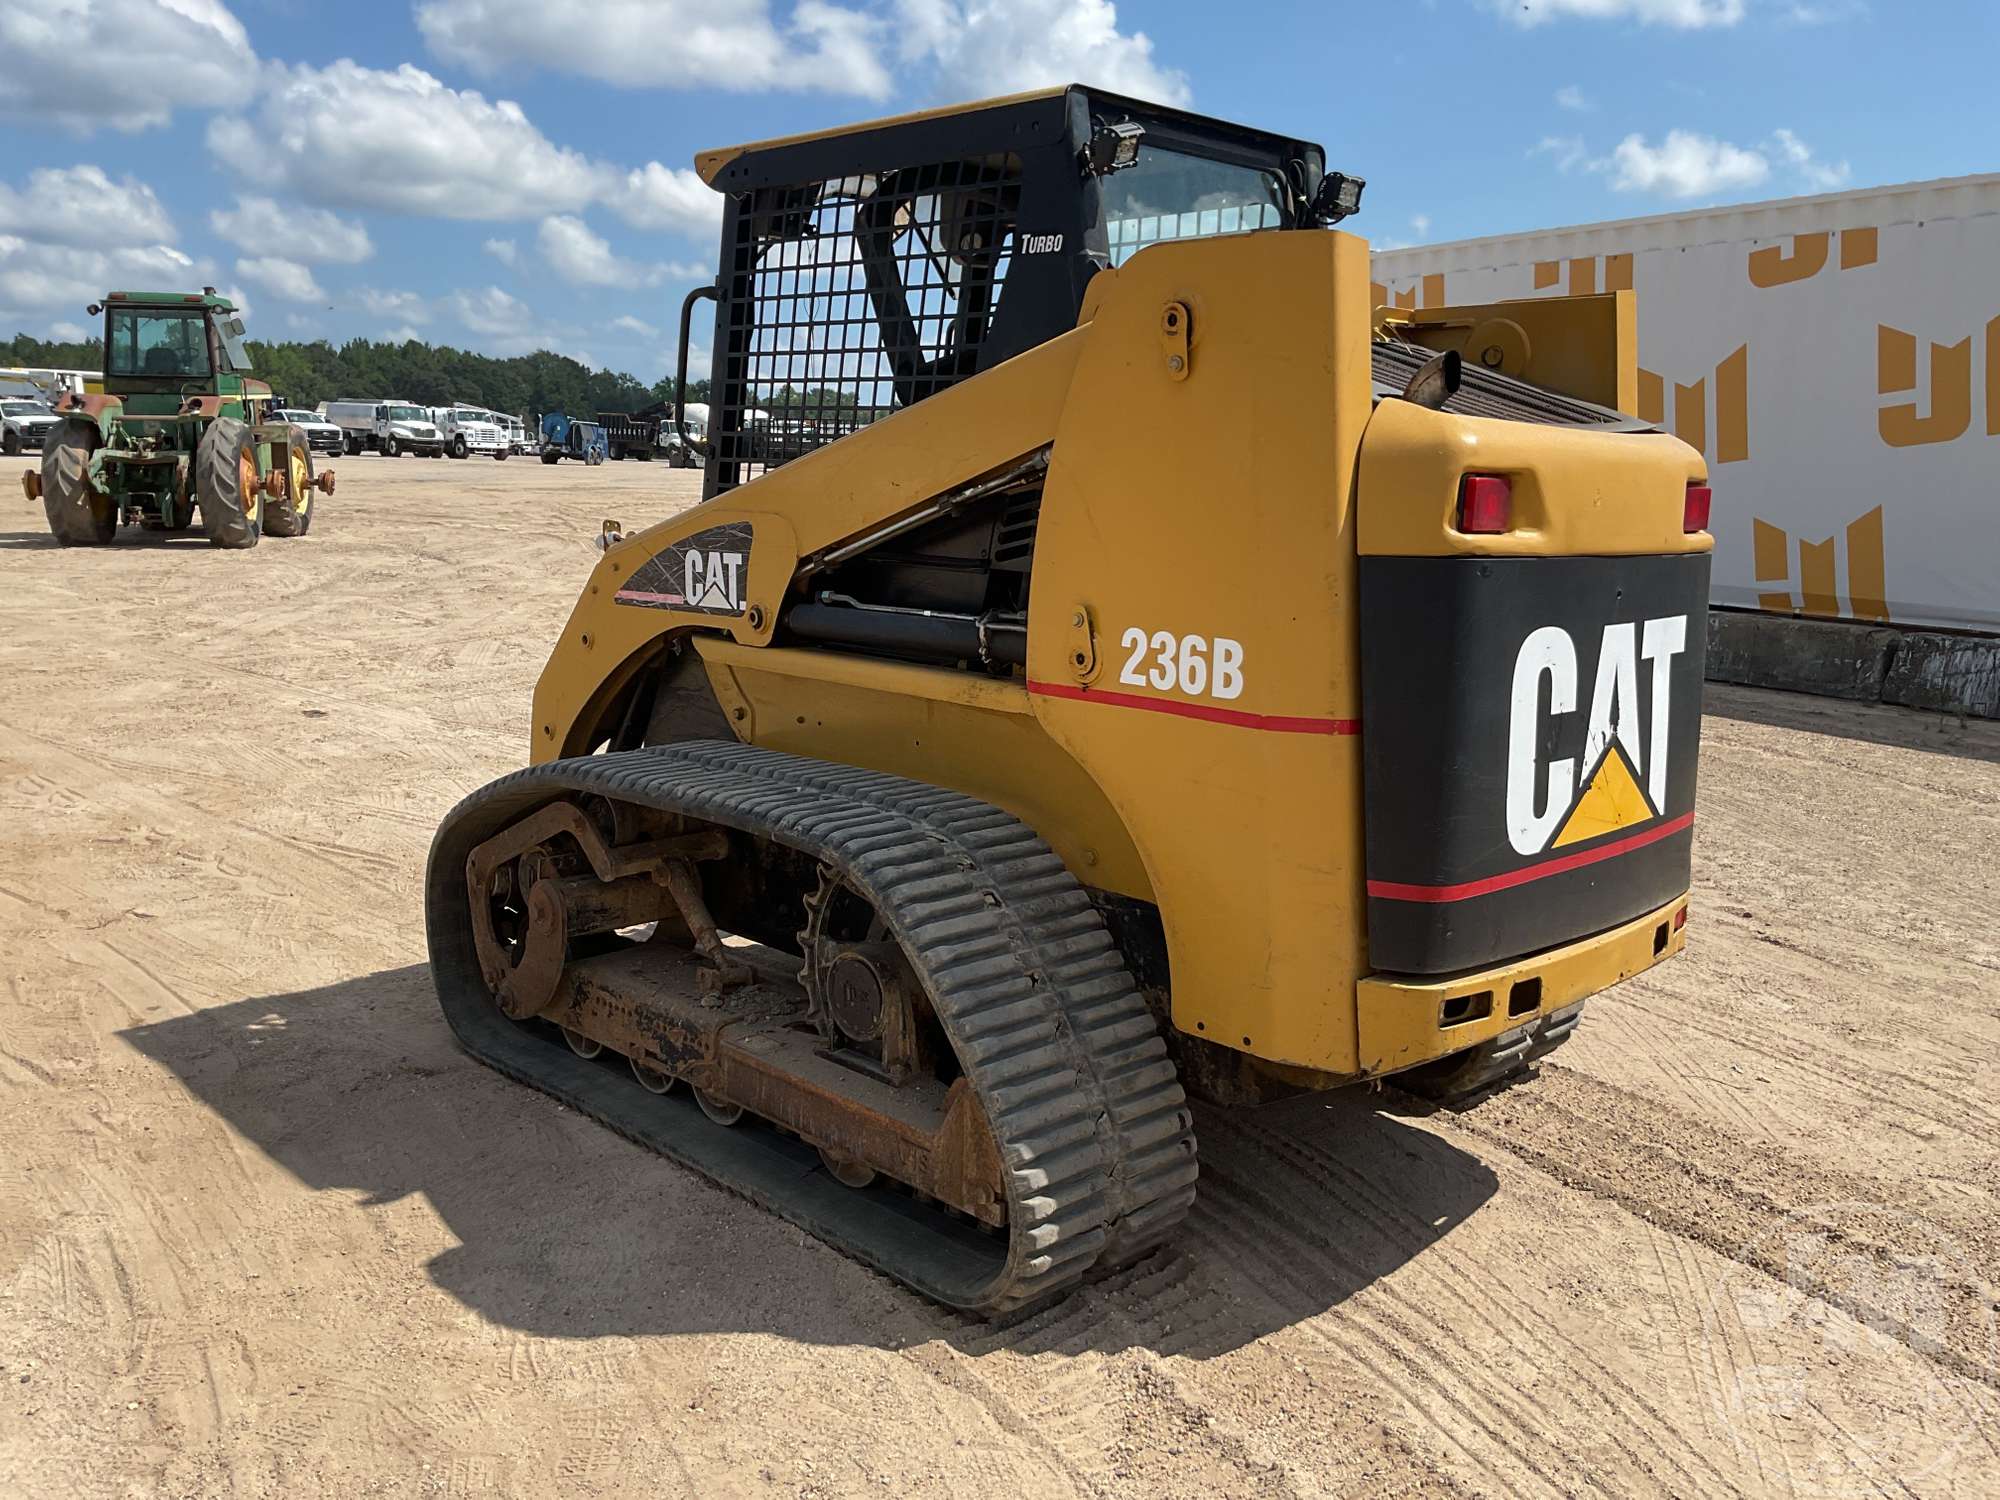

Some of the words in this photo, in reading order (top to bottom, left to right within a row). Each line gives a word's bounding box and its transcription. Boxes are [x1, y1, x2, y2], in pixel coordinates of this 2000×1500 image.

[1021, 234, 1063, 254] TURBO
[684, 549, 743, 609] CAT
[1119, 627, 1244, 700] 236B
[1507, 615, 1687, 856] CAT
